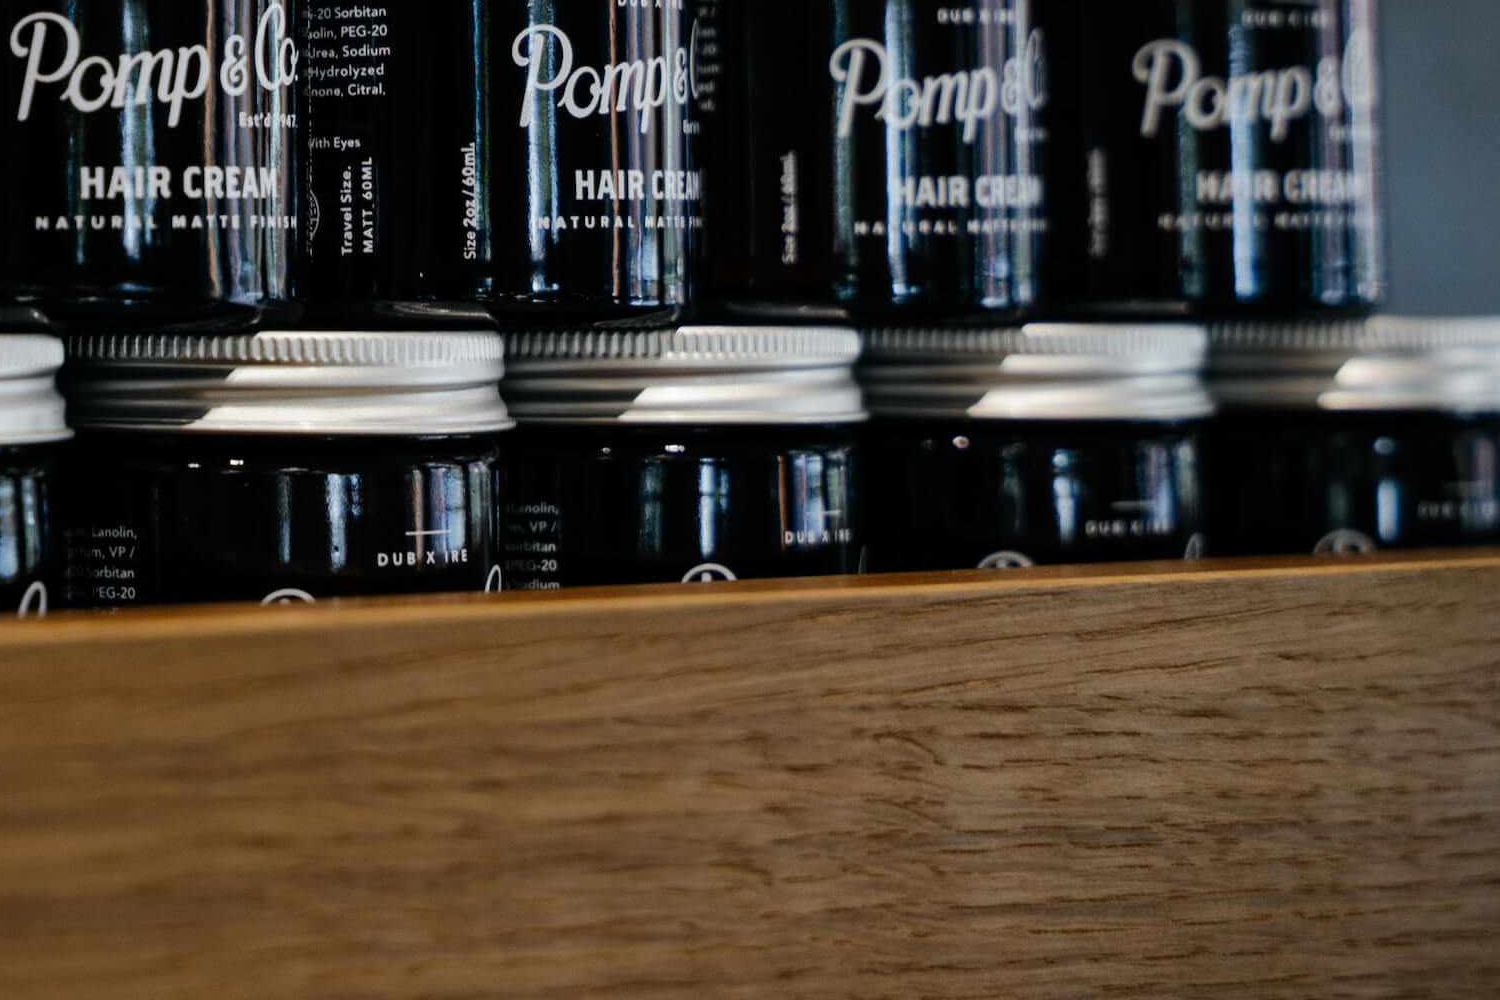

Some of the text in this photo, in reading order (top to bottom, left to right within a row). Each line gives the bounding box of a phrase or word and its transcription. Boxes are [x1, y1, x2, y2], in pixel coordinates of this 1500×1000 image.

[334, 5, 387, 18] Sorbitan
[340, 24, 388, 38] PEG-20
[342, 43, 391, 58] Sodium
[10, 12, 211, 129] Pomp
[220, 34, 248, 97] &
[309, 62, 385, 80] Hydrolyzed
[512, 24, 667, 133] Pomp
[672, 47, 688, 104] &
[347, 82, 386, 97] Citral,
[829, 38, 997, 143] Pomp
[1132, 37, 1312, 142] Pomp
[333, 136, 361, 151] Eyes
[80, 165, 278, 199] HAIR CREAM
[361, 156, 373, 200] 60ML
[575, 169, 645, 200] HAIR
[1196, 169, 1279, 204] HAR
[35, 215, 157, 231] NATURAL
[171, 215, 240, 230] MATTE
[340, 165, 353, 256] Travel Size.
[539, 215, 635, 229] NATURAL
[463, 231, 476, 260] Size
[377, 548, 468, 567] DUB X IRE
